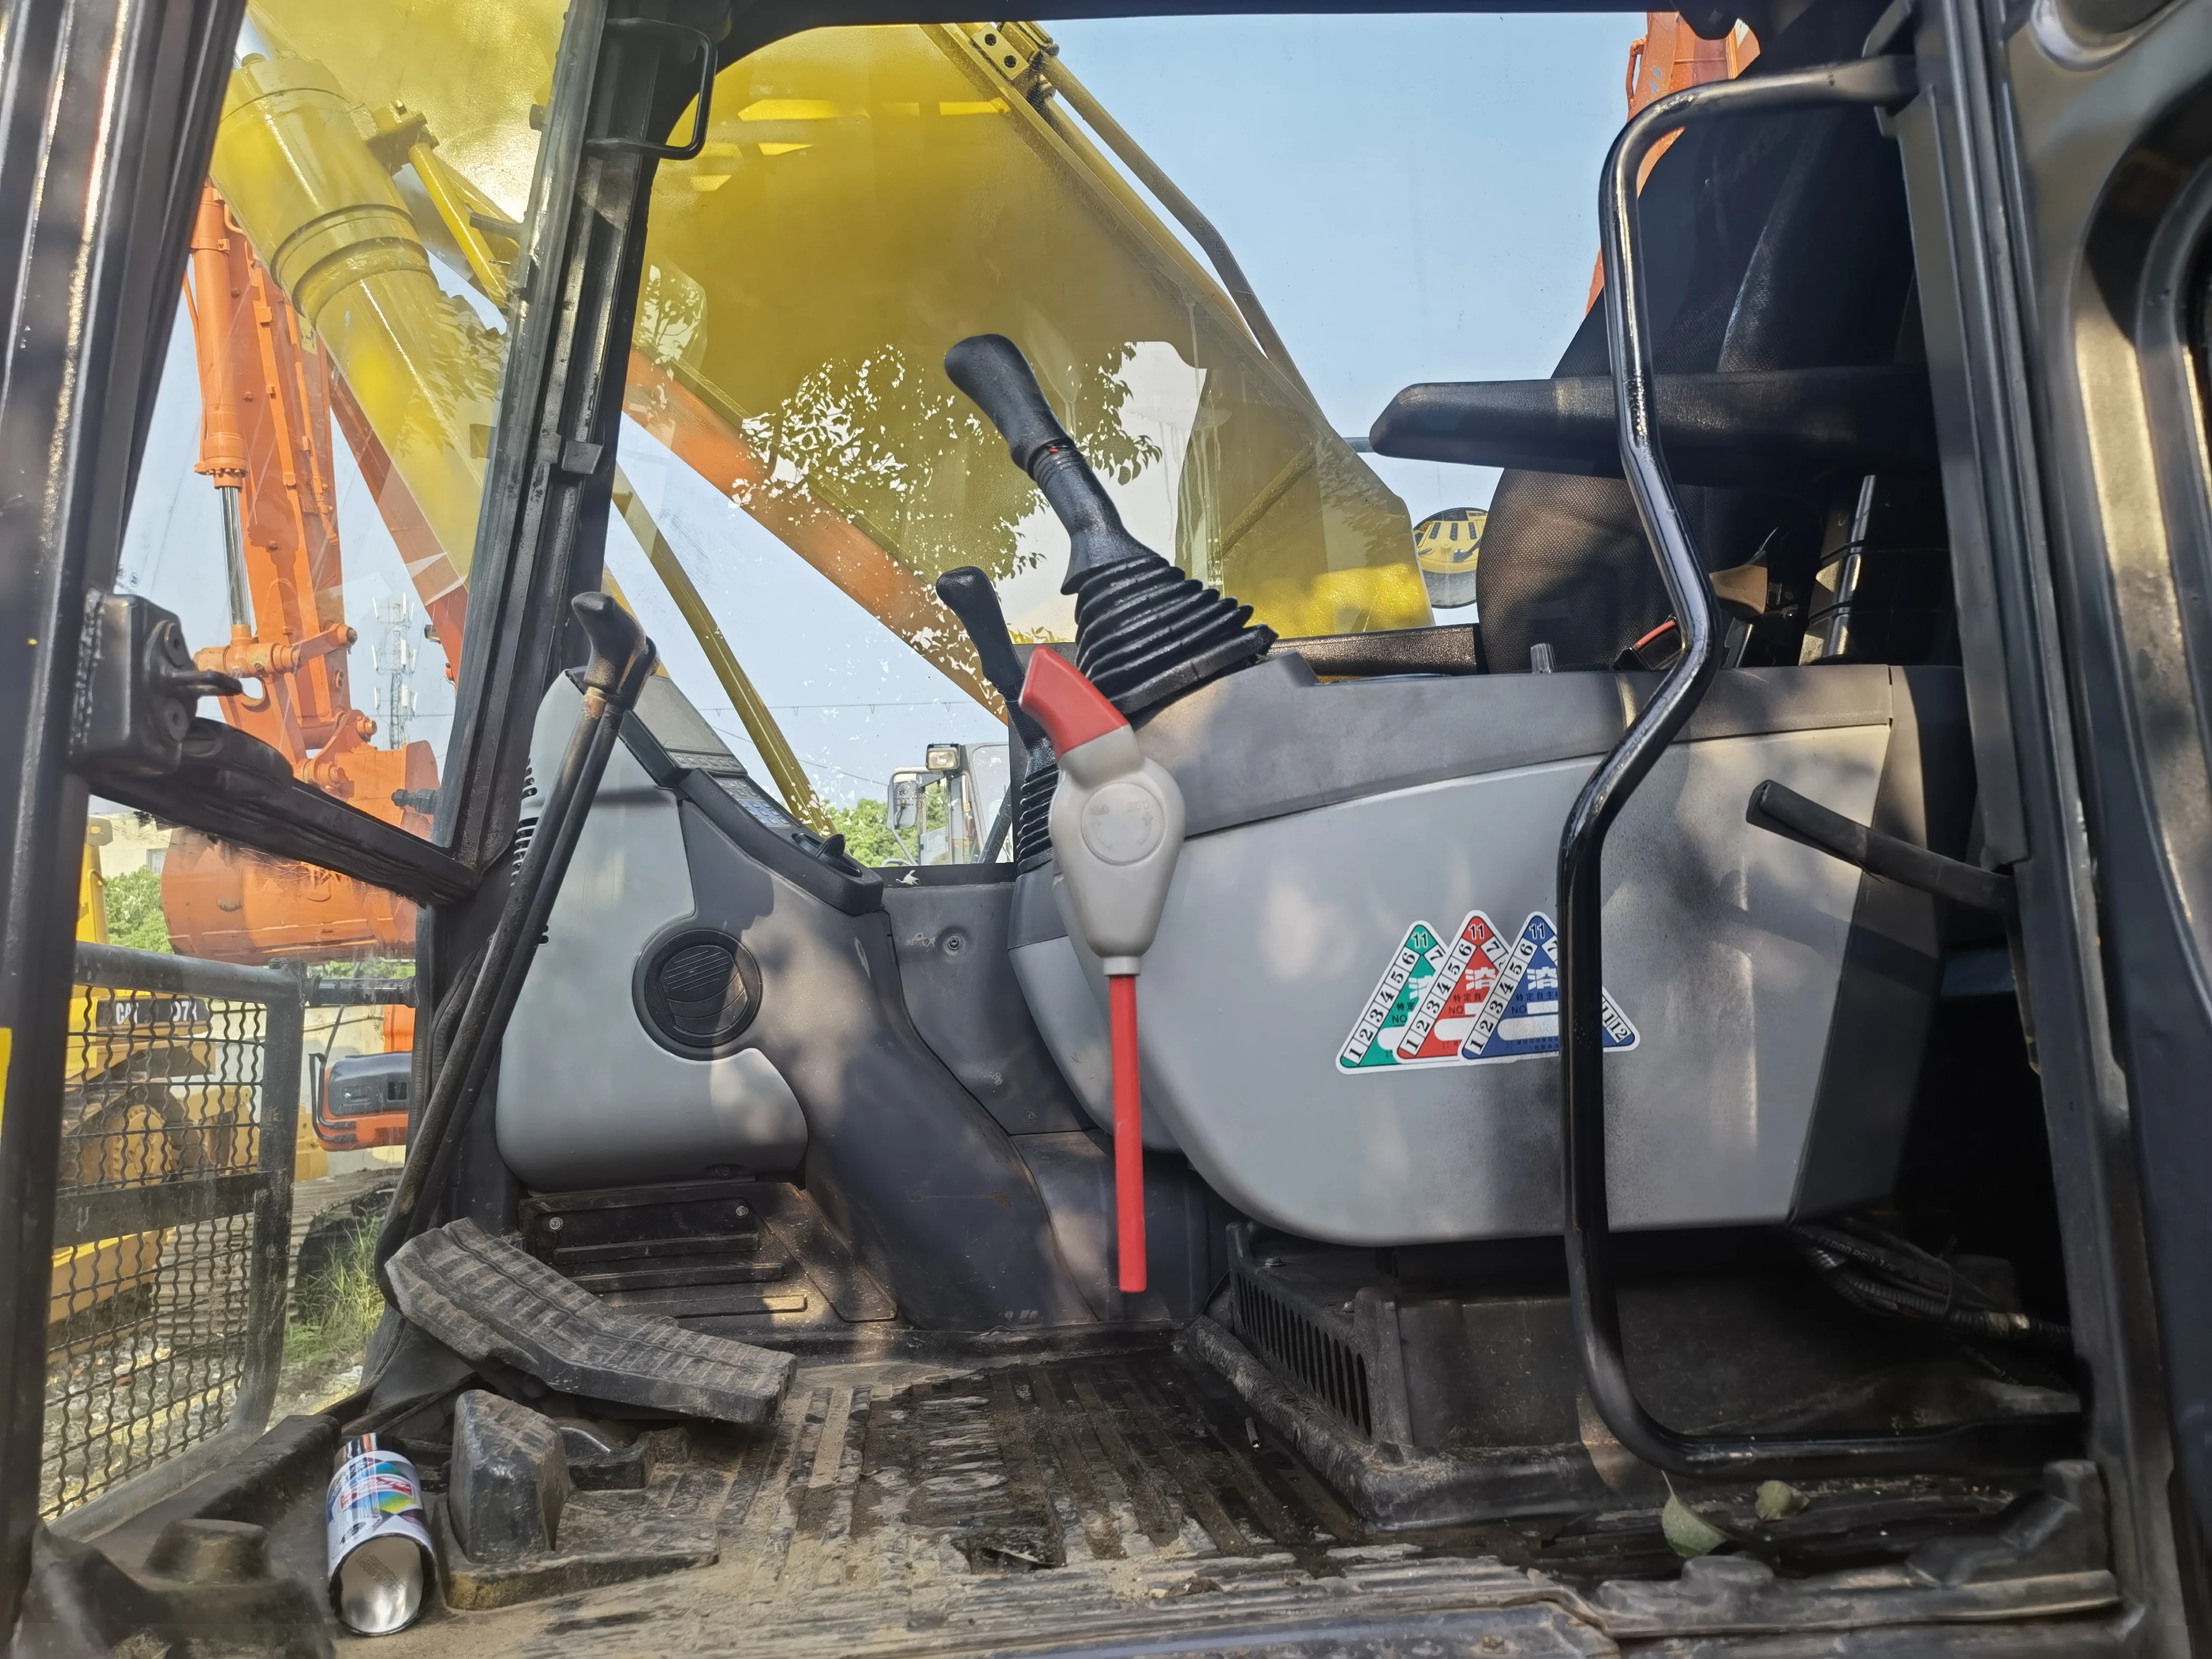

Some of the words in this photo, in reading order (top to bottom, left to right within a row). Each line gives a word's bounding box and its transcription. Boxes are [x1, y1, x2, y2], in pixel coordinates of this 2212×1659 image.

[1468, 923, 1485, 940] 11
[1529, 923, 1545, 940] 11
[1413, 932, 1429, 948] 11
[1486, 940, 1500, 953] 7
[1429, 949, 1444, 961] 7
[1406, 1039, 1420, 1051] 1
[1416, 1020, 1430, 1033] 2
[1426, 1000, 1440, 1014] 3
[1437, 982, 1451, 995] 4
[1447, 962, 1460, 975] 5
[1459, 943, 1472, 956] 6
[1470, 1039, 1485, 1051] 1
[1480, 1020, 1494, 1033] 2
[1489, 1000, 1503, 1014] 3
[1499, 981, 1514, 995] 4
[1509, 962, 1522, 975] 5
[1520, 943, 1533, 956] 6
[1349, 1048, 1363, 1060] 1
[1359, 1029, 1373, 1041] 2
[1370, 1009, 1384, 1023] 3
[1380, 991, 1394, 1003] 4
[1391, 970, 1404, 984] 5
[1402, 952, 1415, 965] 6
[1448, 1006, 1464, 1015] NO
[1512, 1006, 1526, 1014] NO
[1392, 1014, 1407, 1023] NO
[1610, 1021, 1628, 1041] 12
